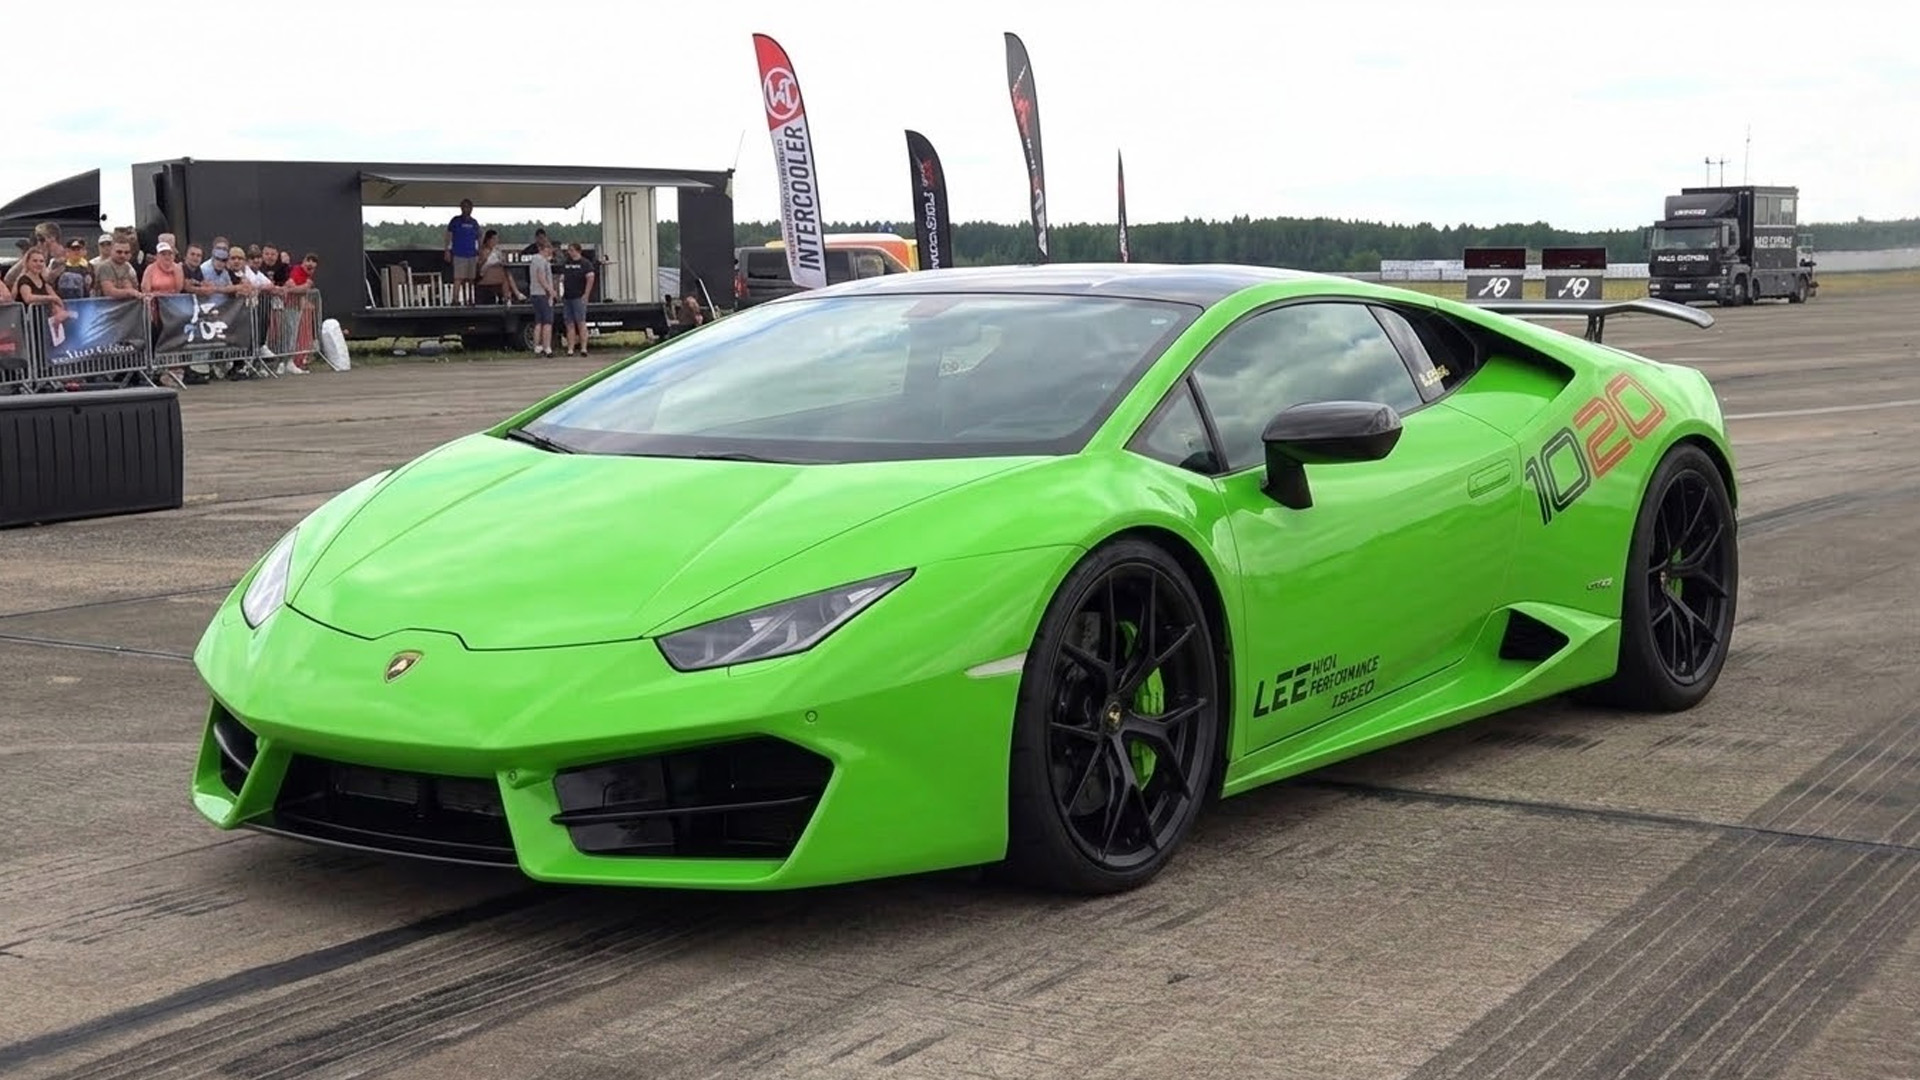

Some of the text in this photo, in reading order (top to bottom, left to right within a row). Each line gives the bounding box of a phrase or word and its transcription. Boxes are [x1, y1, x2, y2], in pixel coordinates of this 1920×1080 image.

[784, 125, 821, 272] INTERCOOLER
[1525, 372, 1666, 525] 1020
[1253, 662, 1311, 718] LEE
